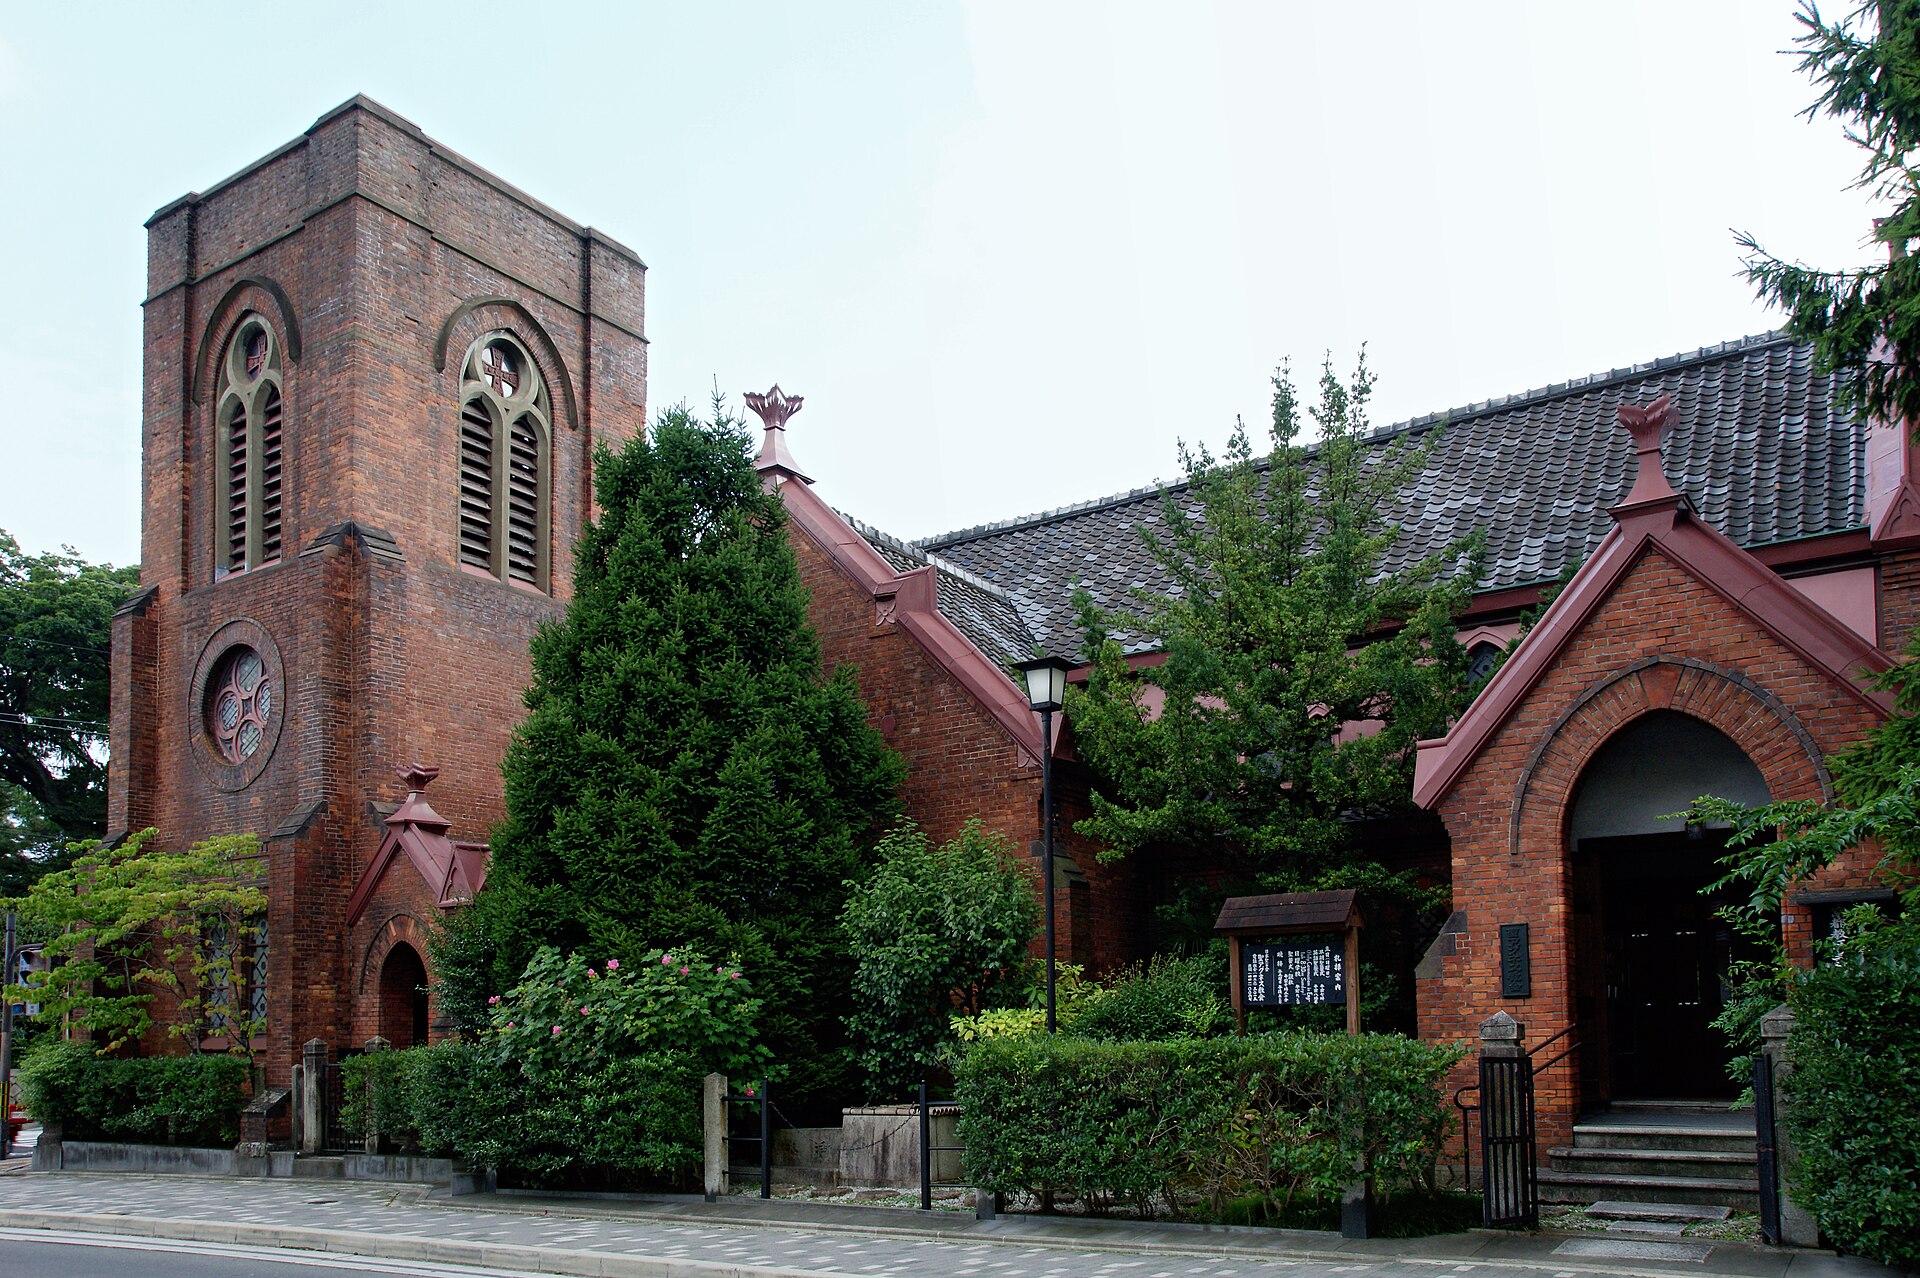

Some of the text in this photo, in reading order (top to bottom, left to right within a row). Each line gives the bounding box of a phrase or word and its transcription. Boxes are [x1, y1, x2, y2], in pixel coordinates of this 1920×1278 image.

[1257, 953, 1266, 1002] 聖アグネス教会
[1333, 954, 1342, 991] 礼拝案内
[1506, 928, 1522, 992] 聖アグネス教会
